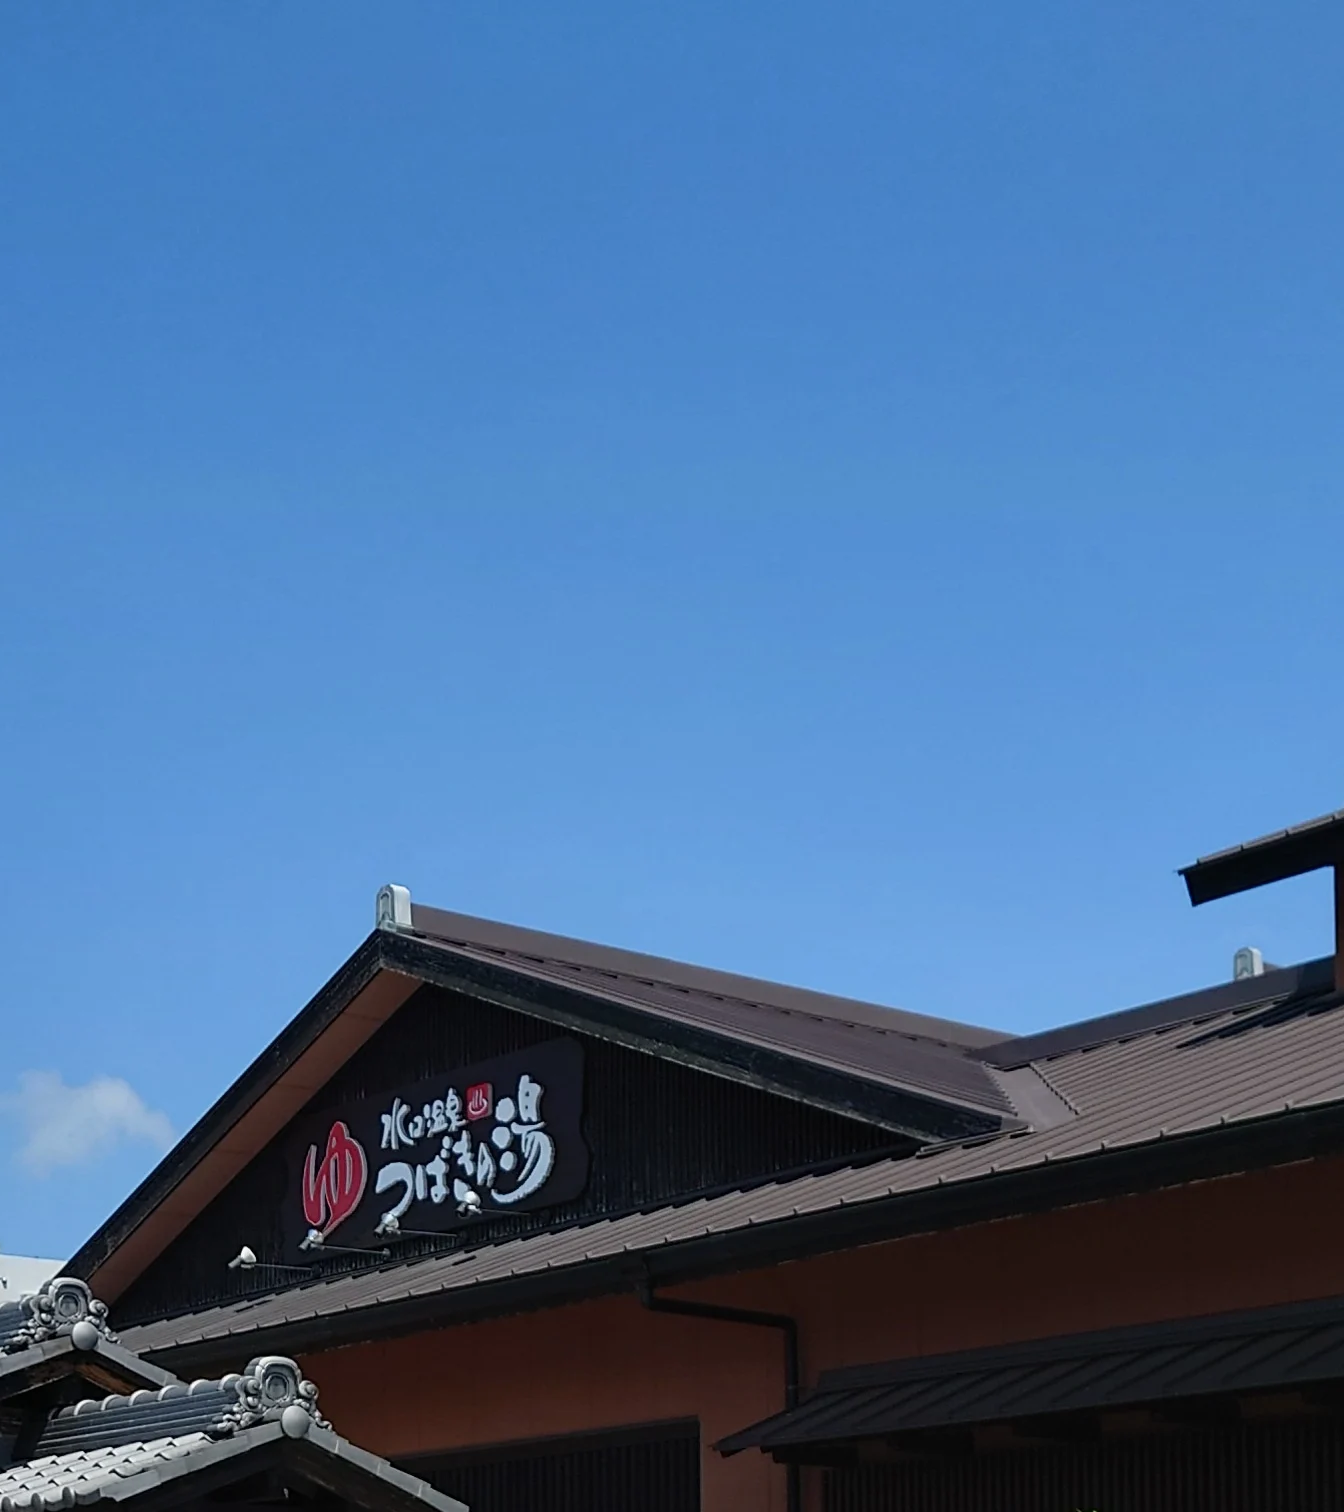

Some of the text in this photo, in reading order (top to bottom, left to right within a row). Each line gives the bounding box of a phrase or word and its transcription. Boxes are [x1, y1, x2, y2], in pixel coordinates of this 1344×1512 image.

[381, 1087, 469, 1150] 水口温泉
[302, 1121, 367, 1232] ゆ
